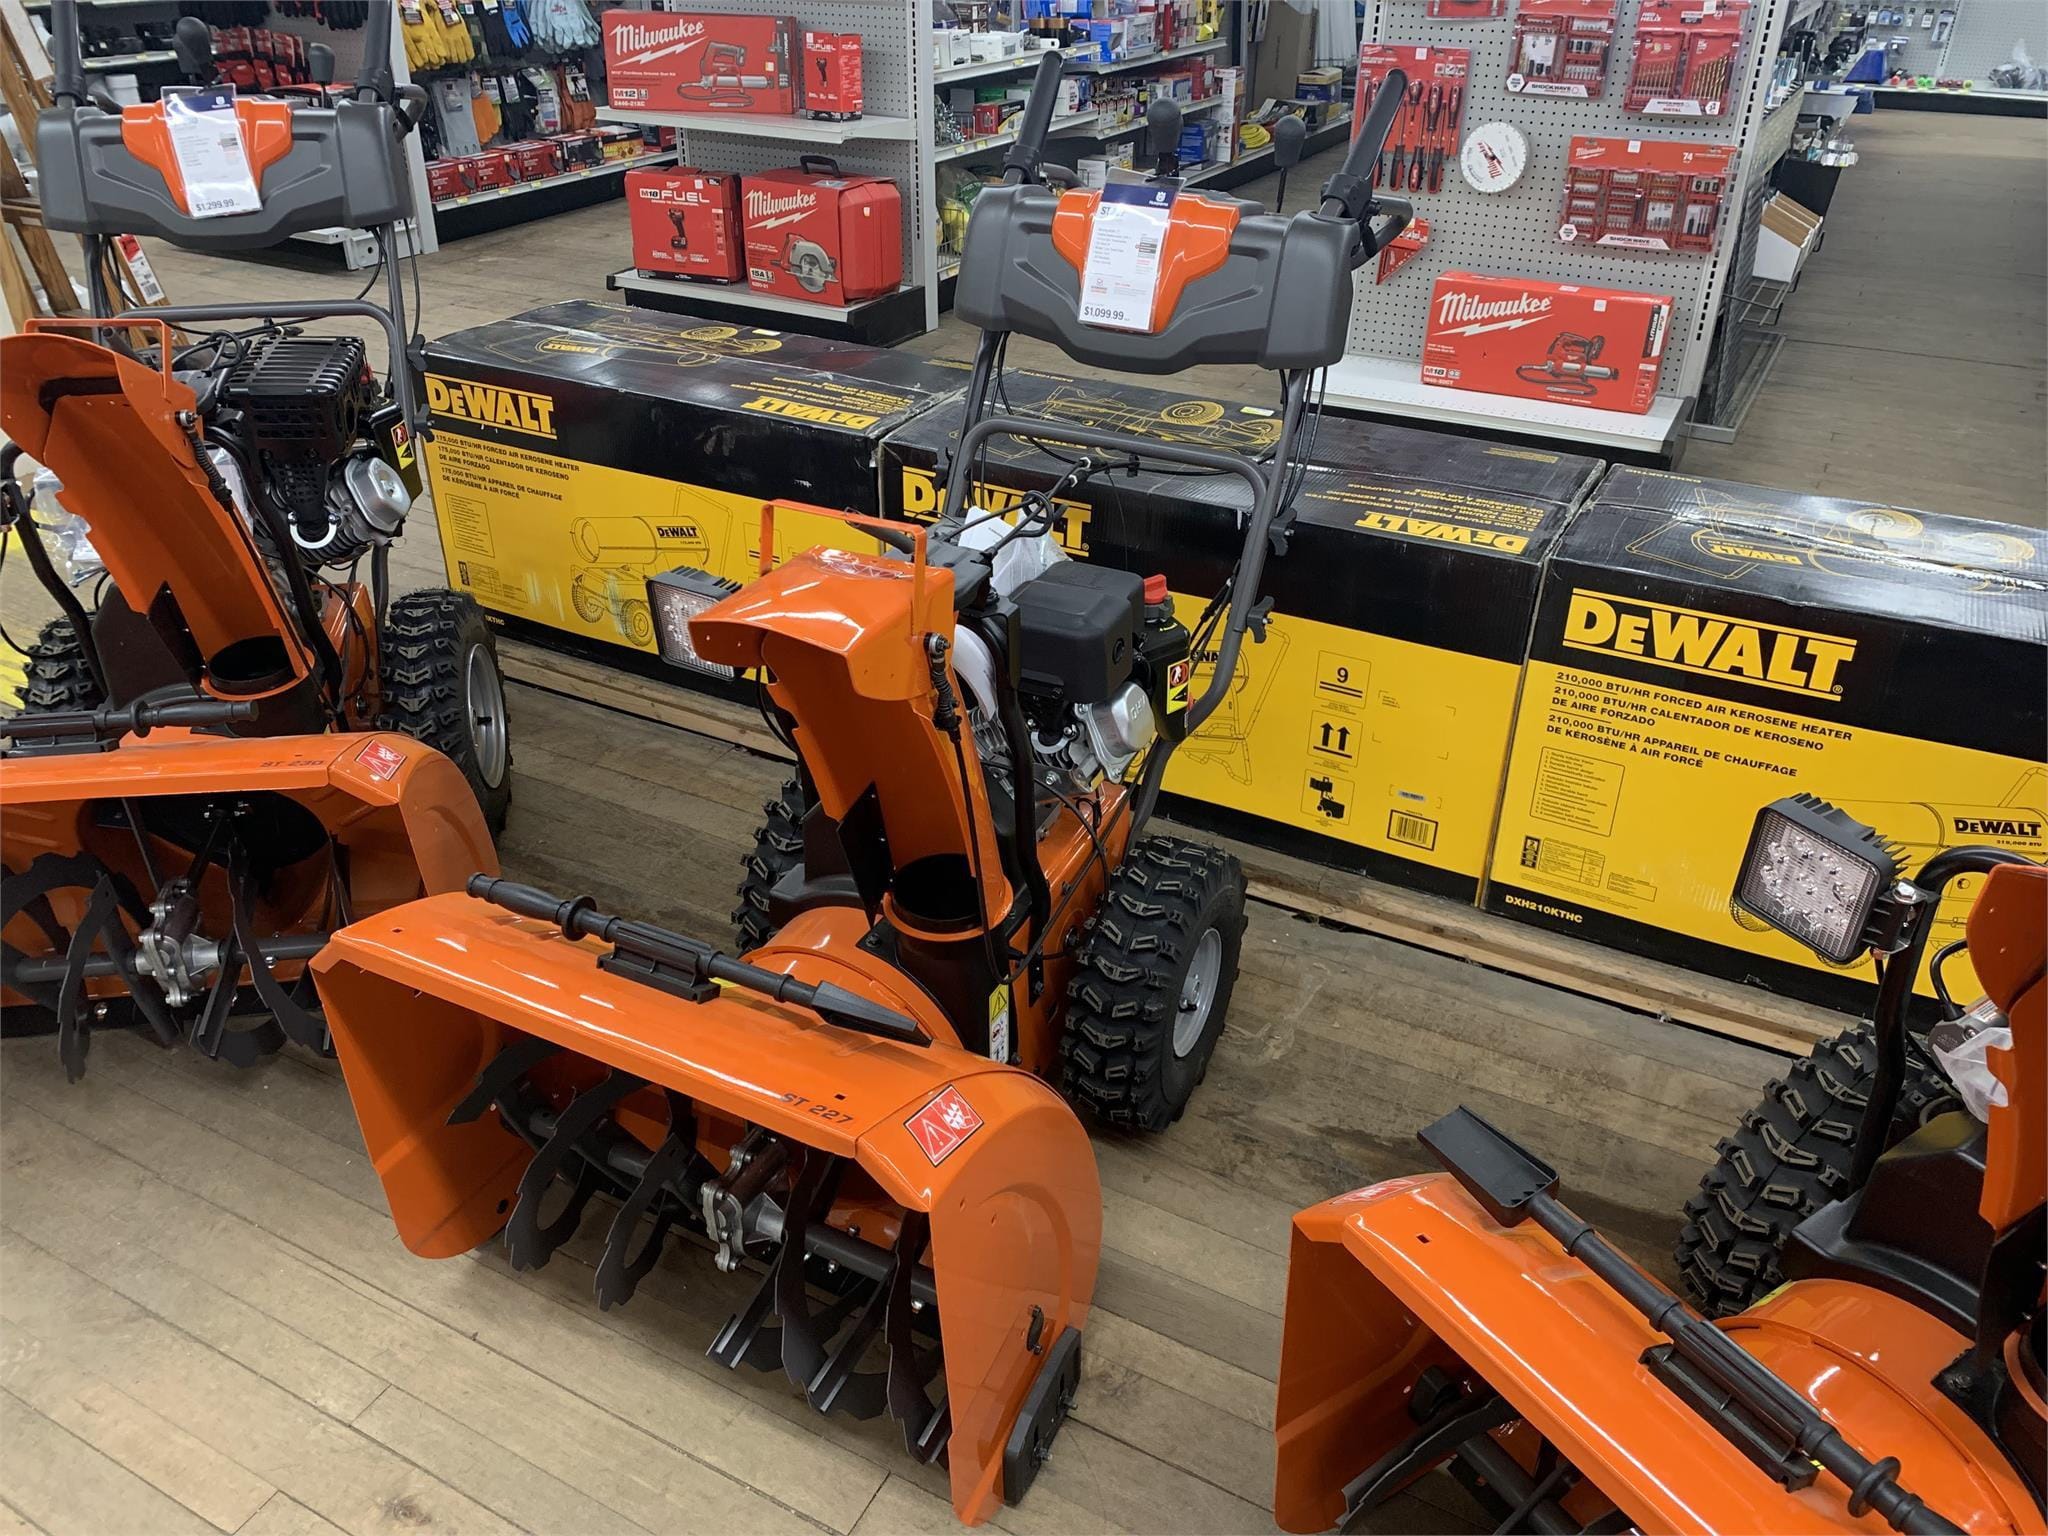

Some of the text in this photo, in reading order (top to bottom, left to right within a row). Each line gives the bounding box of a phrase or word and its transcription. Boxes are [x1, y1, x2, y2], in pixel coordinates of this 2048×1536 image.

[609, 19, 704, 56] Milwaukee
[196, 198, 234, 212] $1,299.99
[662, 190, 710, 203] FUEL
[746, 189, 816, 219] Milwaukee
[1084, 306, 1124, 320] $1,099.99
[1436, 291, 1552, 326] Milwaukee
[1650, 313, 1658, 340] LITHIUM
[425, 377, 554, 435] DEWALT
[740, 395, 881, 430] DEWALT
[436, 434, 580, 471] 175,000 BTU/HR FORCED AIR KEROSENE HEATER
[438, 446, 460, 455] 175,000
[462, 451, 483, 460] BTU/HR
[485, 456, 524, 469] CALENTADOR
[535, 468, 569, 480] KEROSENO
[448, 456, 461, 464] AIRE
[463, 460, 490, 470] FORZADO
[442, 467, 463, 477] 175,000
[465, 472, 487, 482] BTU/HR
[488, 478, 516, 490] APPAREIL
[527, 487, 562, 500] CHAUFFAGE
[657, 526, 698, 538] DEWALT
[1357, 511, 1530, 553] DEWALT
[1710, 545, 1802, 565] DEWALT
[1564, 594, 1855, 693] DEWALT
[1337, 667, 1349, 683] 9
[1552, 697, 1656, 727] DE AIRE FORZADO
[1554, 686, 1824, 751] 210,000 BTU/HR CALENTADOR DE KEROSENO
[1557, 671, 1853, 741] 210,000 BTU/HR FORCED AIR KEROSENE HEATER
[1547, 725, 1563, 735] DE
[1629, 743, 1639, 753] À
[1641, 746, 1660, 758] AIR
[1663, 751, 1704, 768] FORCÉ
[1548, 714, 1797, 776] 210,000 BTU/HR APPAREIL DE CHAUFFAGE
[260, 760, 282, 768] ST
[1954, 819, 2041, 836] DEWALT
[1505, 895, 1583, 924] DXH210KTHC
[781, 1093, 853, 1124] ST 227
